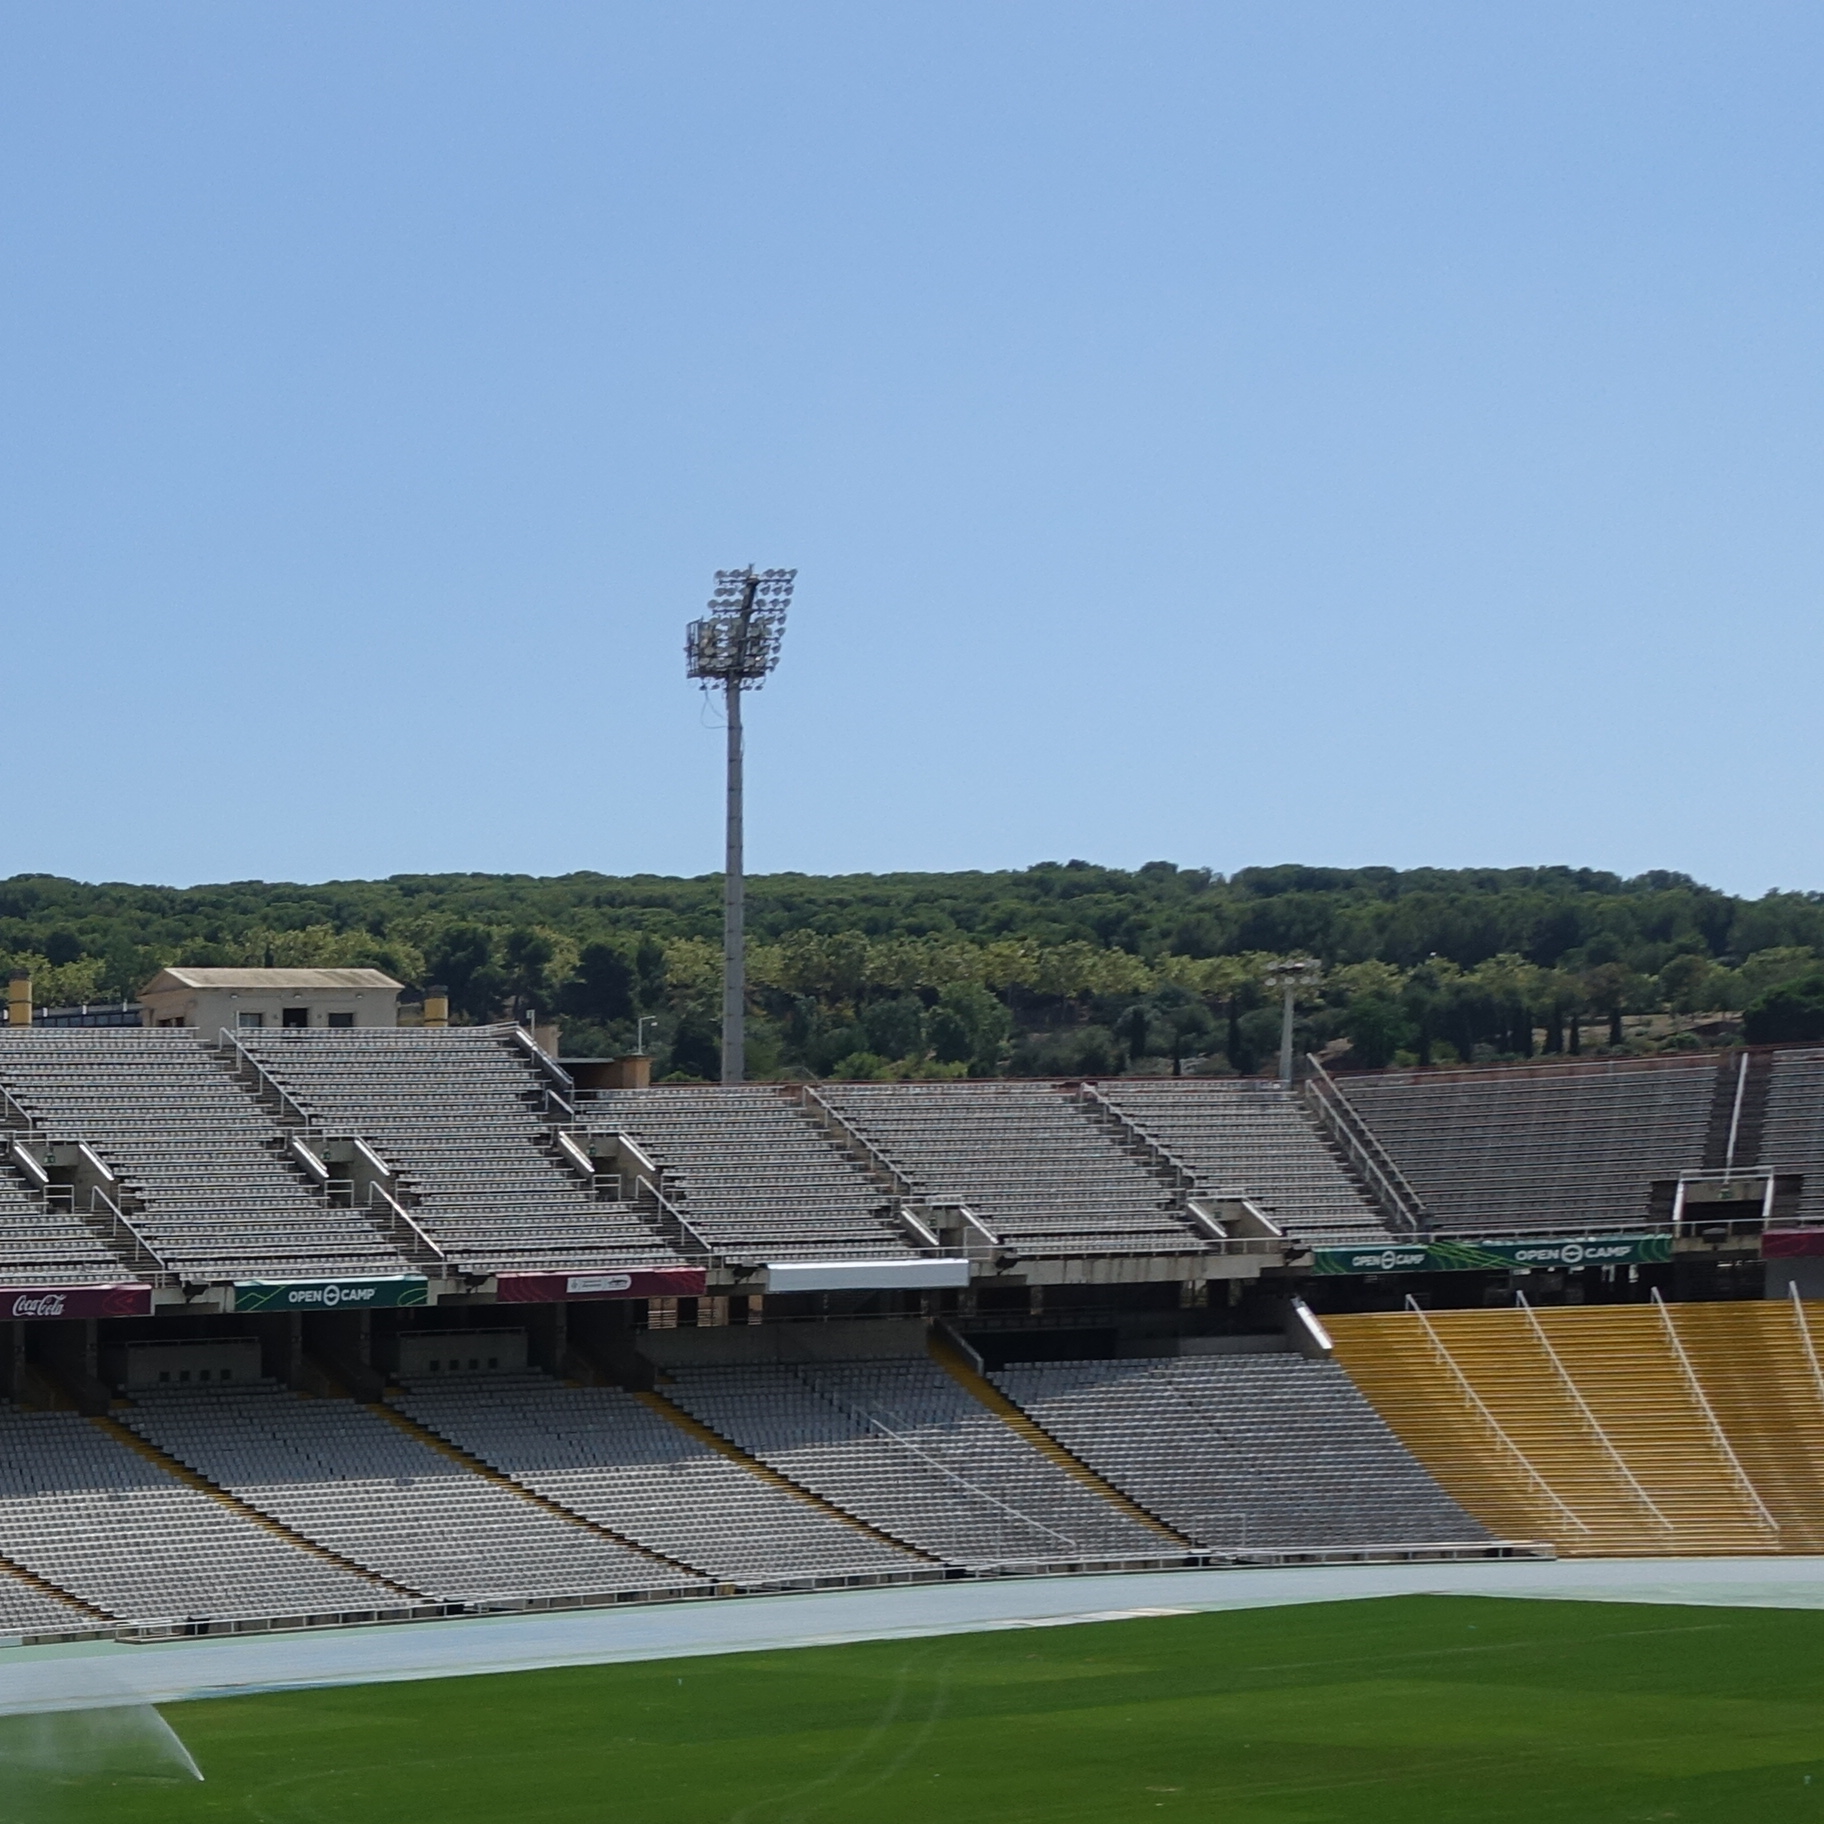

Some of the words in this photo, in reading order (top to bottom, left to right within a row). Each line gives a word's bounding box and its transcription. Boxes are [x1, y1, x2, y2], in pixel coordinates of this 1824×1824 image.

[1352, 1255, 1380, 1267] OPEN
[1396, 1253, 1425, 1266] CAMP
[1515, 1248, 1560, 1261] OPEN
[1583, 1246, 1632, 1259] CAMP
[288, 1289, 321, 1304] OPEN
[341, 1287, 375, 1302] CAMP
[12, 1294, 66, 1317] Coca-Cola
